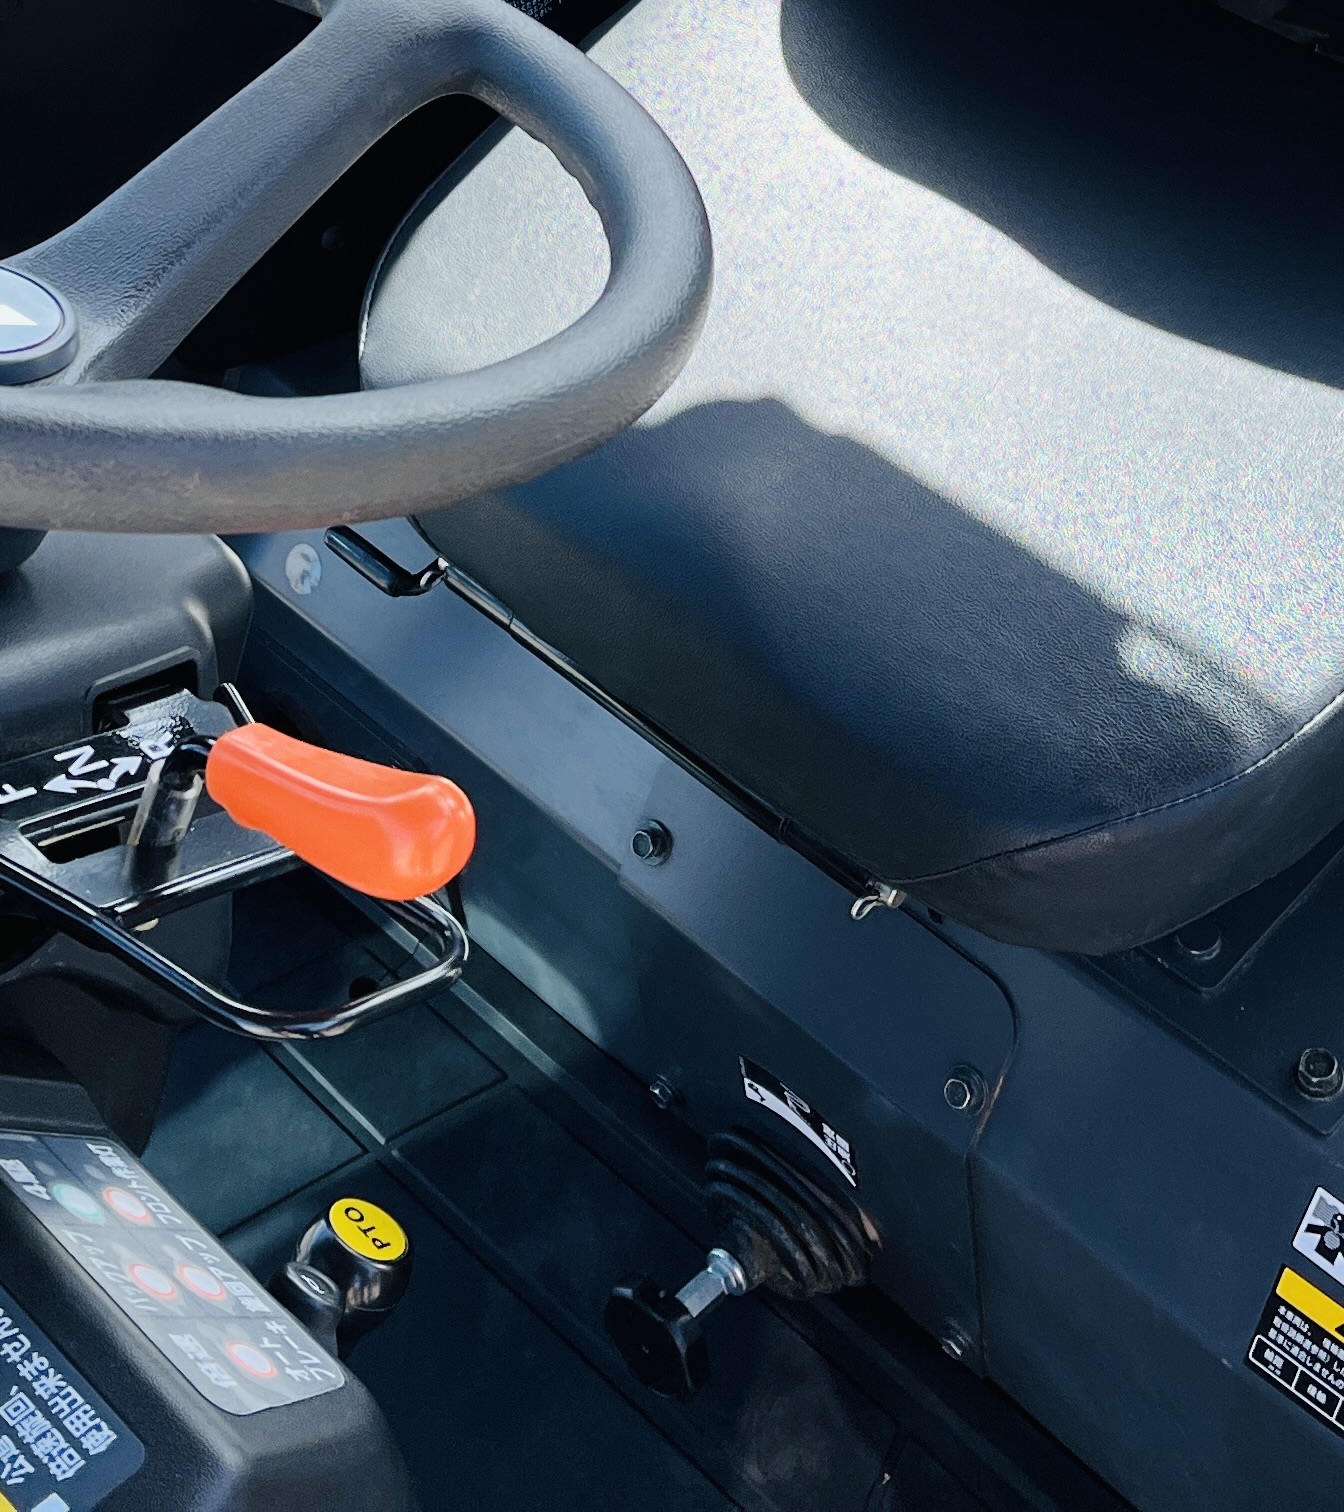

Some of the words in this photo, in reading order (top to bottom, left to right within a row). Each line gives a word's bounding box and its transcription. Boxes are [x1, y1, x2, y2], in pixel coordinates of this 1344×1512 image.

[53, 744, 109, 776] N
[341, 1202, 392, 1252] PTO
[180, 1235, 271, 1311] 旋回アップ
[168, 1332, 237, 1387] 倍速
[257, 1337, 312, 1379] オート
[266, 1320, 335, 1377] ブレーキ
